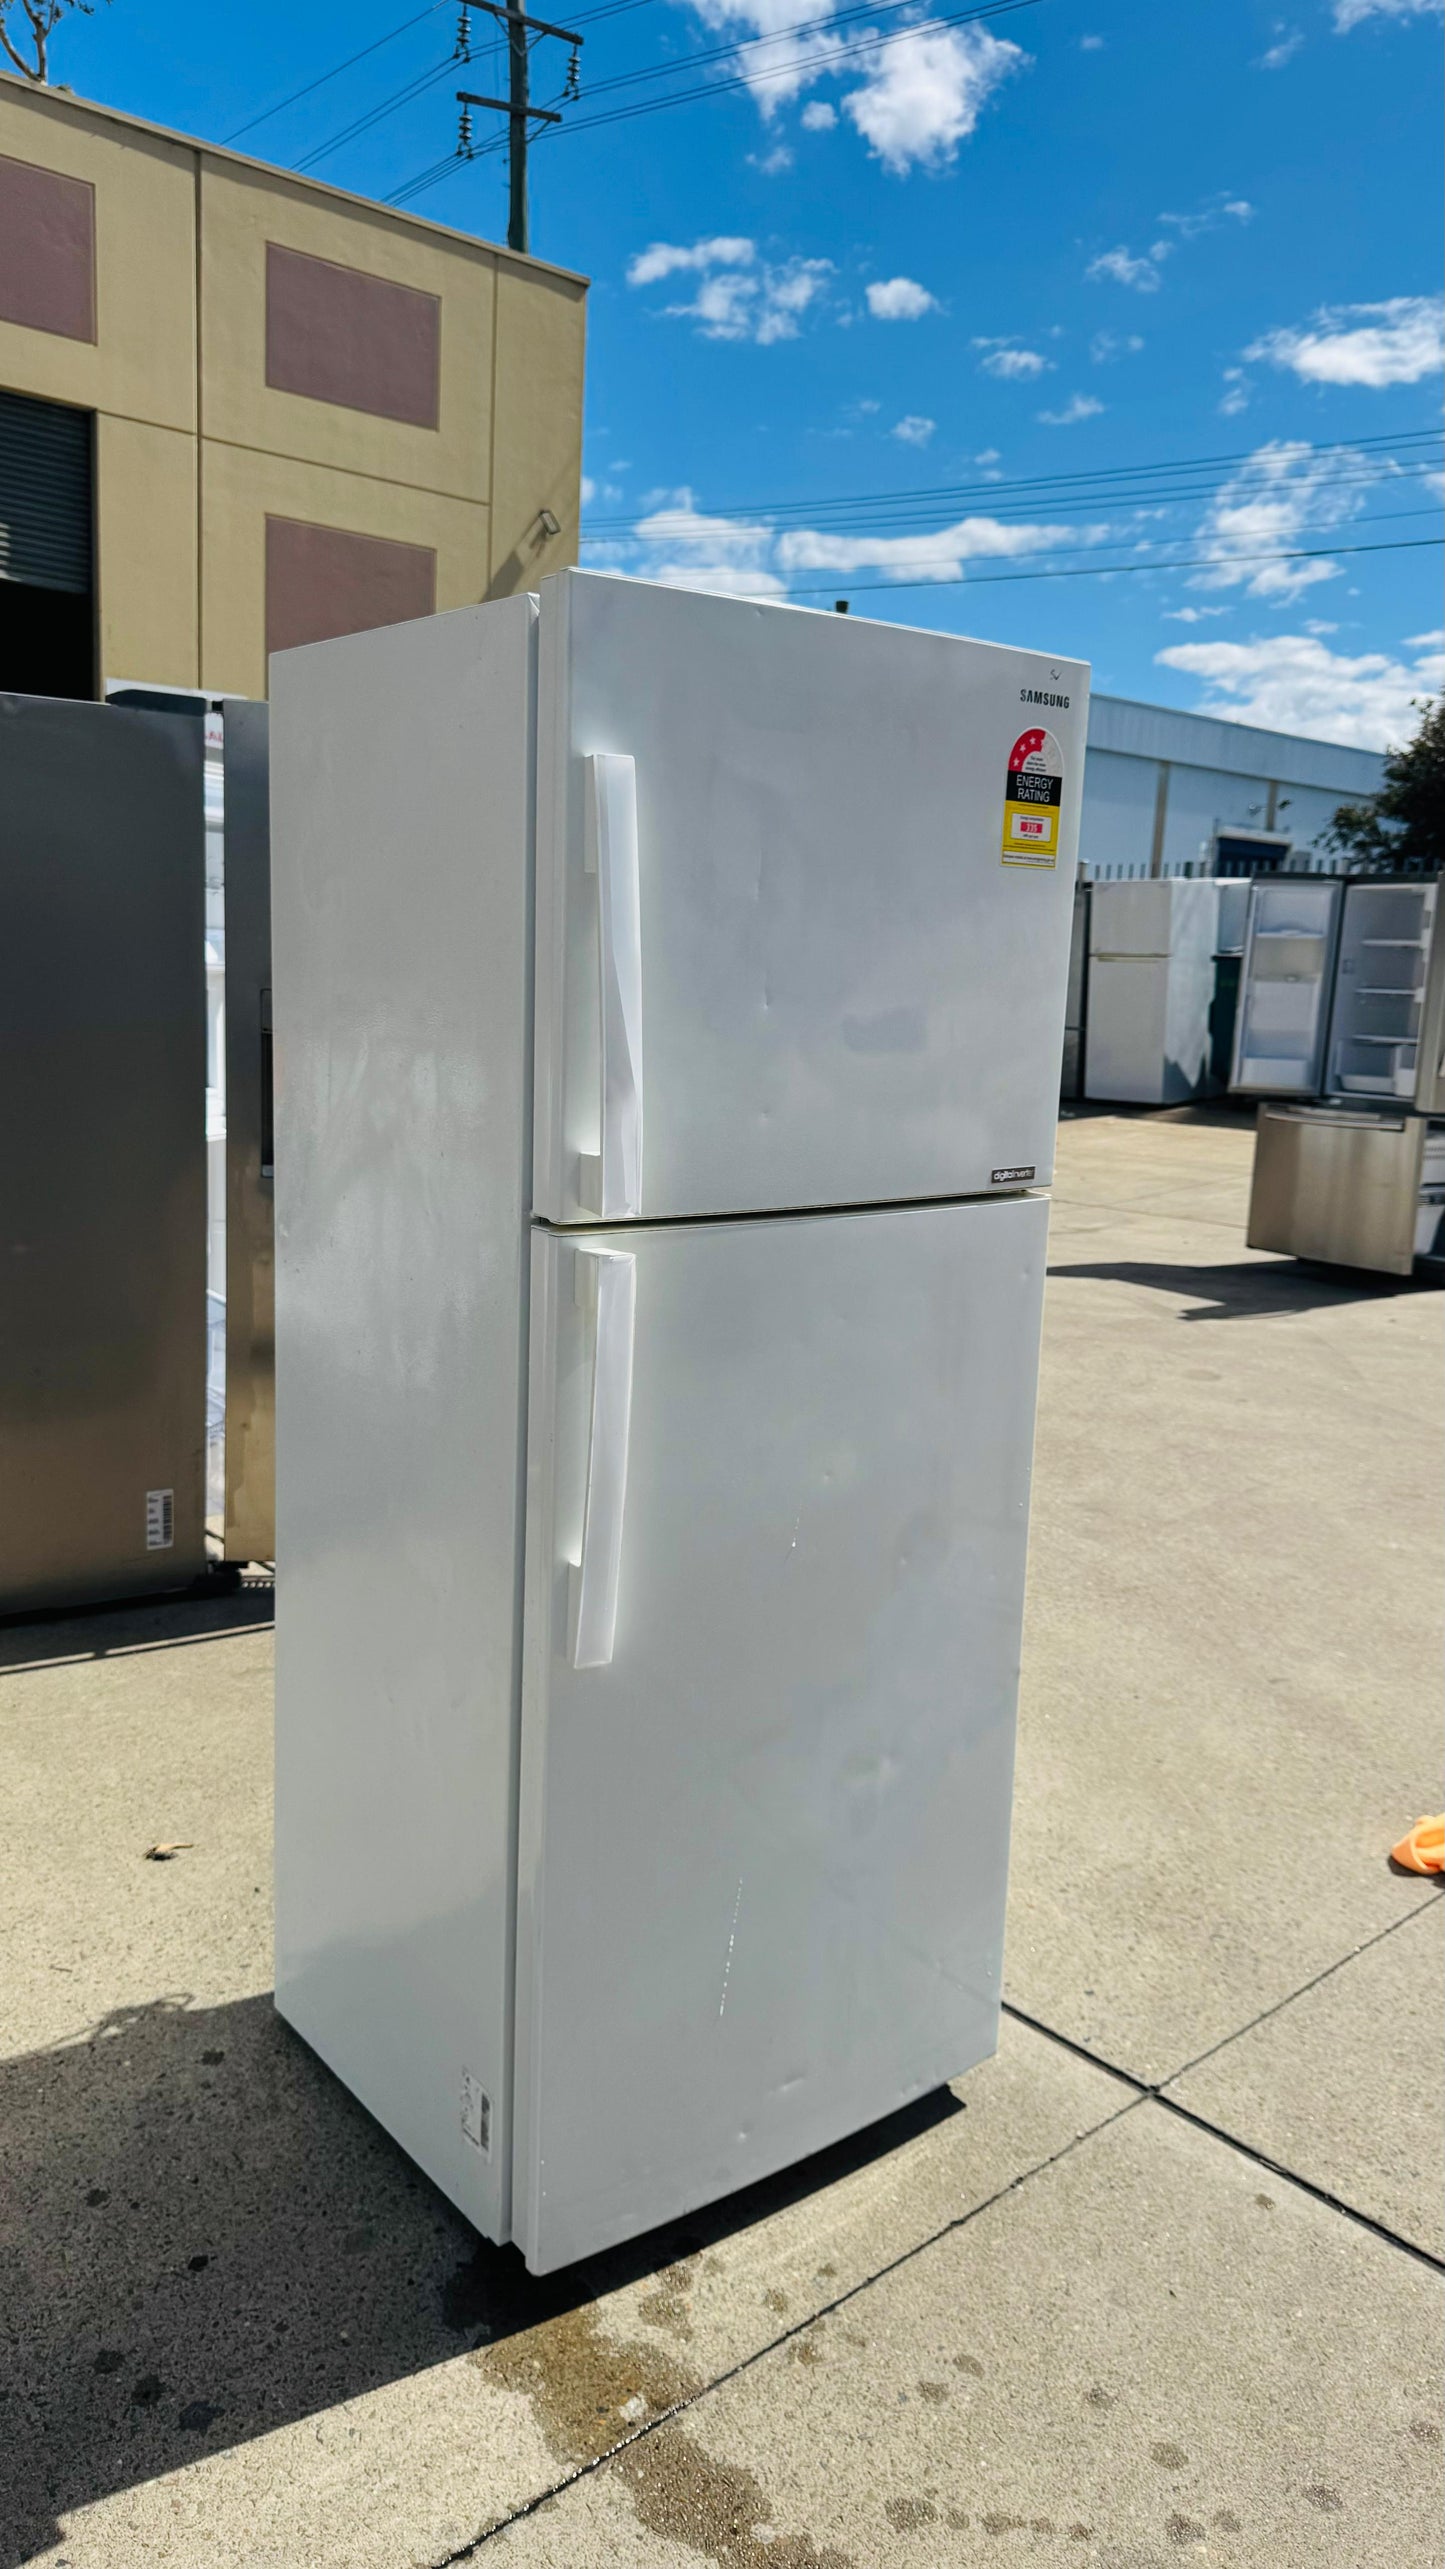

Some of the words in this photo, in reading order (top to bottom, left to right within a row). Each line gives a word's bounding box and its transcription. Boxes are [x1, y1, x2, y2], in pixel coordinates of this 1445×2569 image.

[1020, 689, 1070, 709] SAMSUNG
[1016, 775, 1054, 790] ENERGY
[1017, 788, 1050, 802] RATING
